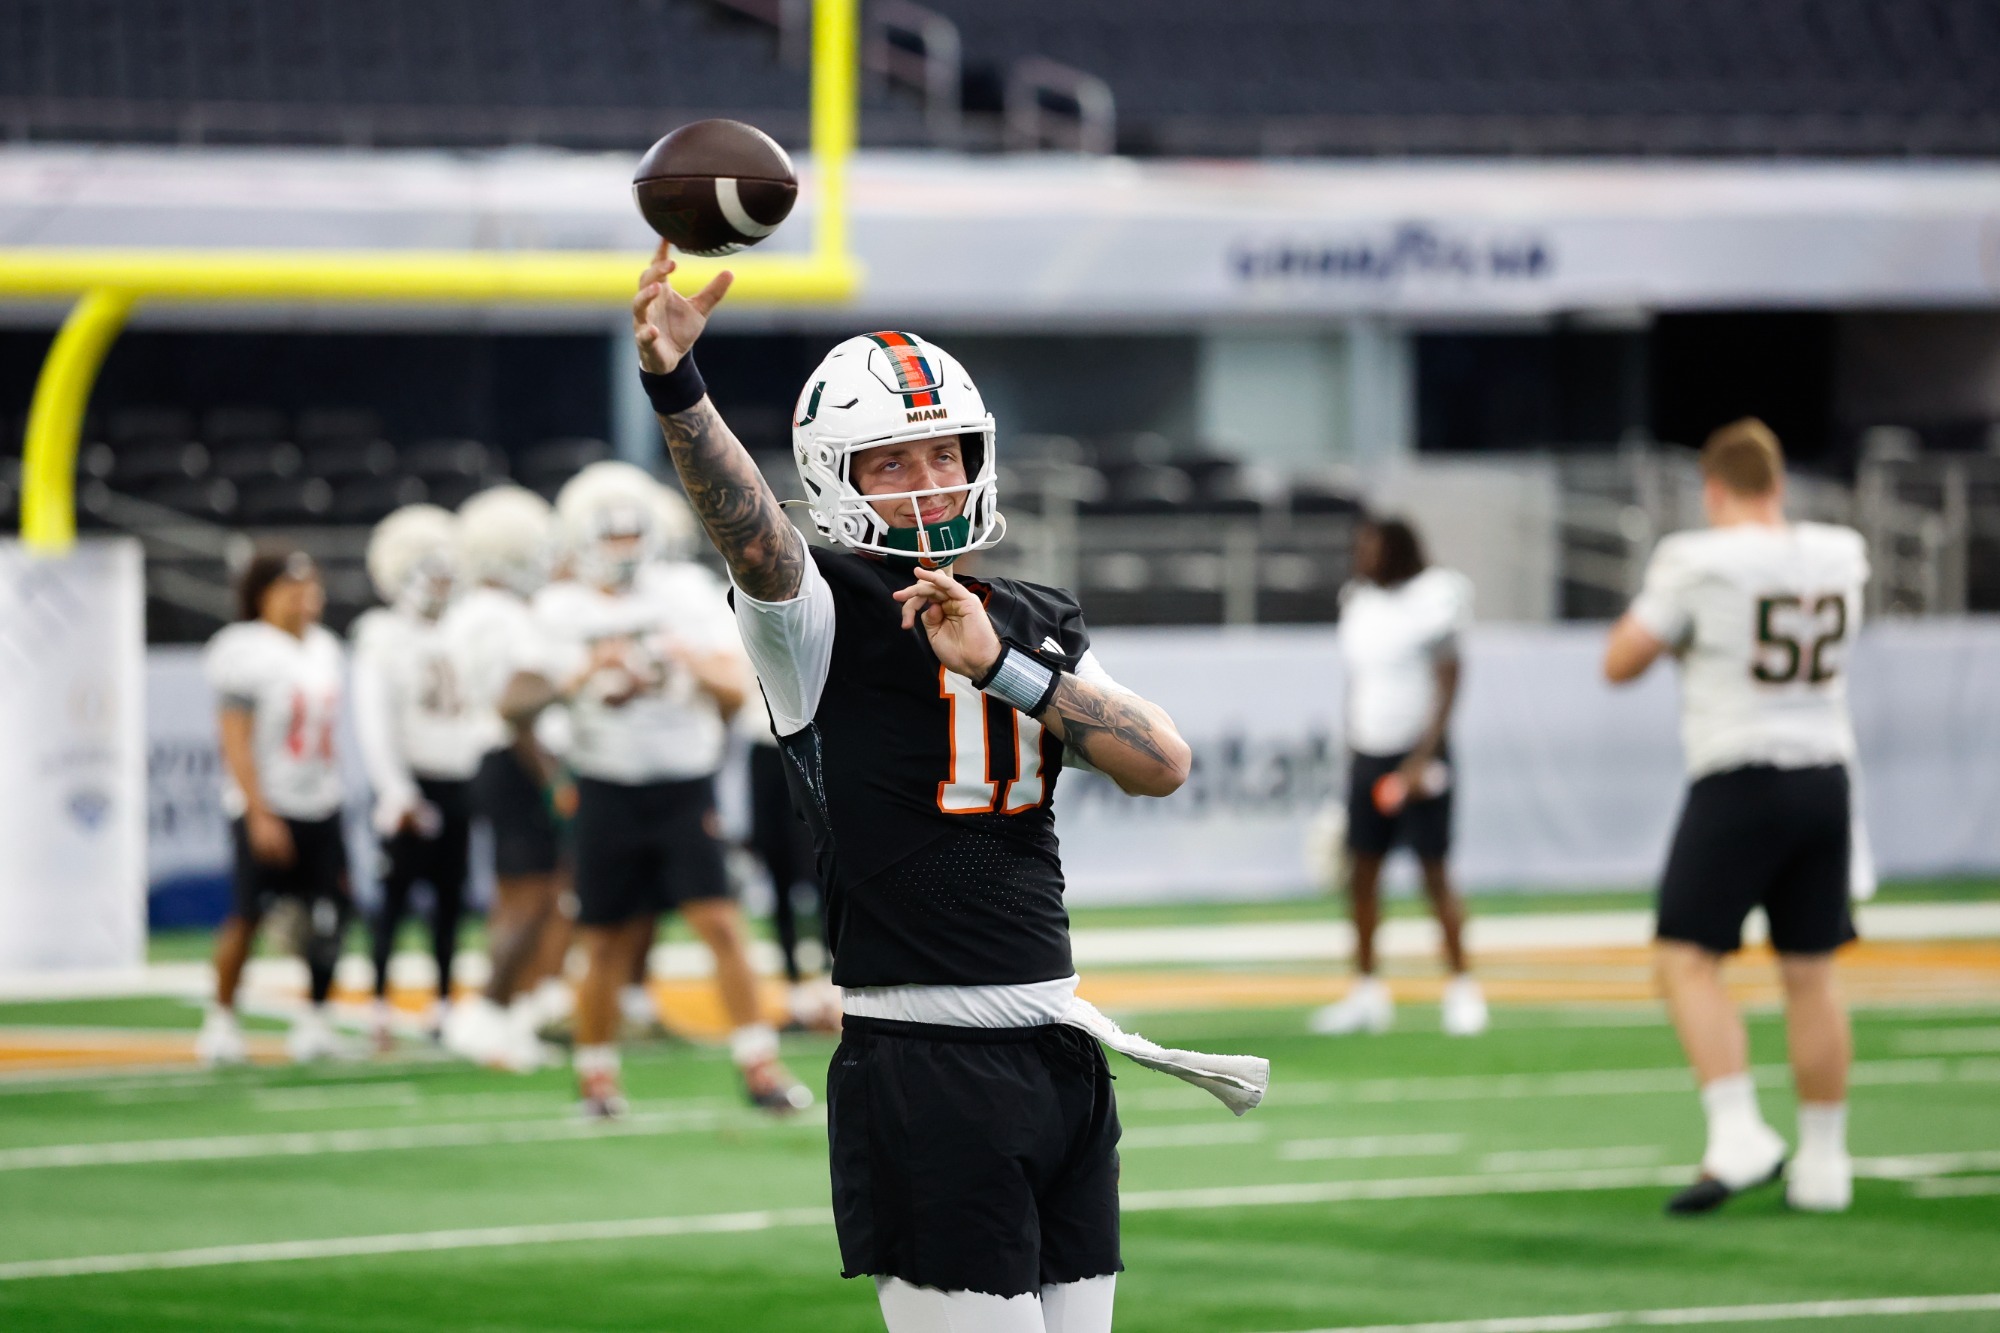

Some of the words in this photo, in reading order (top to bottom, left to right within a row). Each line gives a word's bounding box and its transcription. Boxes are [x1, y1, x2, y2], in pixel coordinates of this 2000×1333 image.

[906, 408, 948, 424] MIAMI
[1751, 593, 1847, 684] 52
[937, 664, 1045, 816] 11
